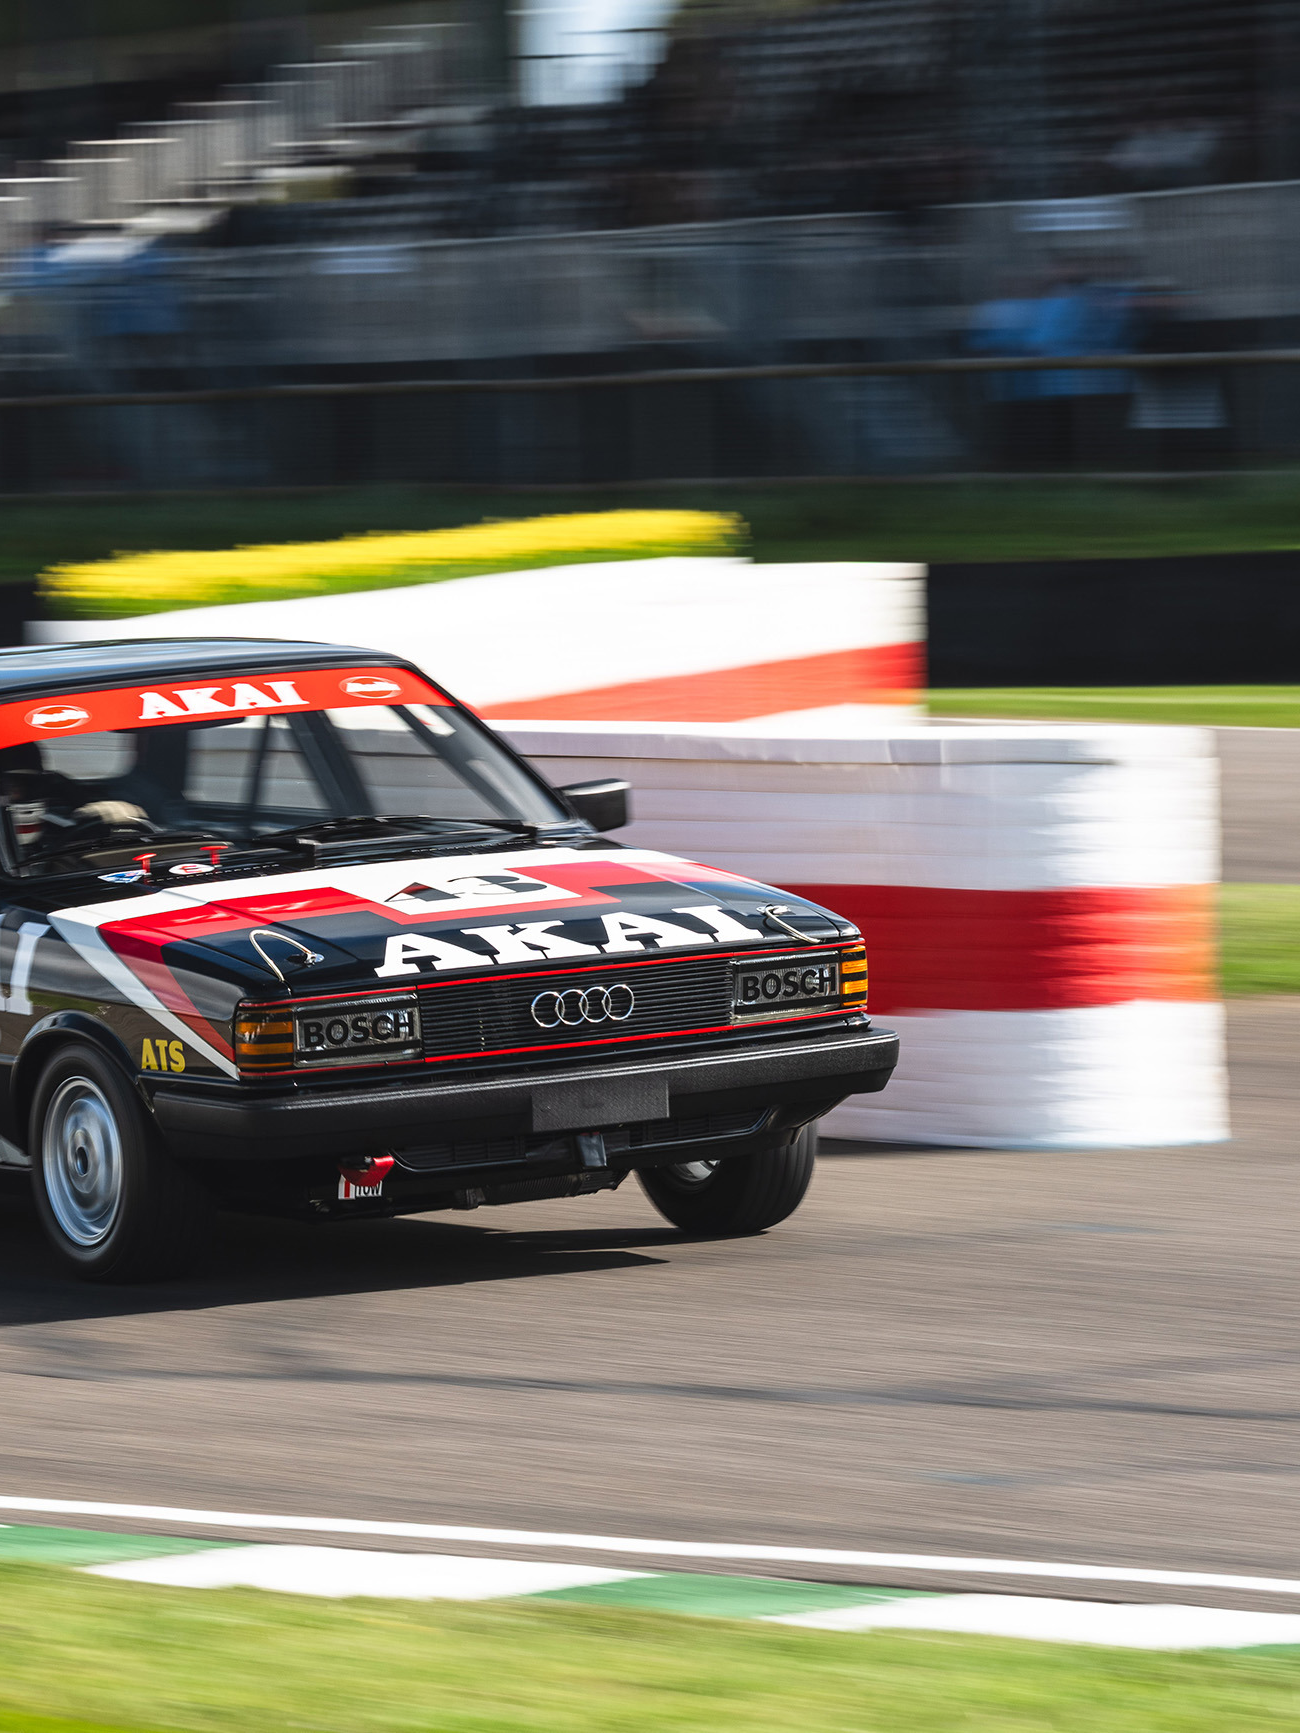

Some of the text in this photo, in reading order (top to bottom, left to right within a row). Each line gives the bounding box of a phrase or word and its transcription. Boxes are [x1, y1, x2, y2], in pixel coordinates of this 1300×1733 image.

[138, 680, 310, 720] AKAI
[373, 904, 765, 978] AKAI
[742, 966, 836, 1001] BOSCH
[303, 1011, 414, 1048] BOSCH
[141, 1038, 186, 1072] ATS
